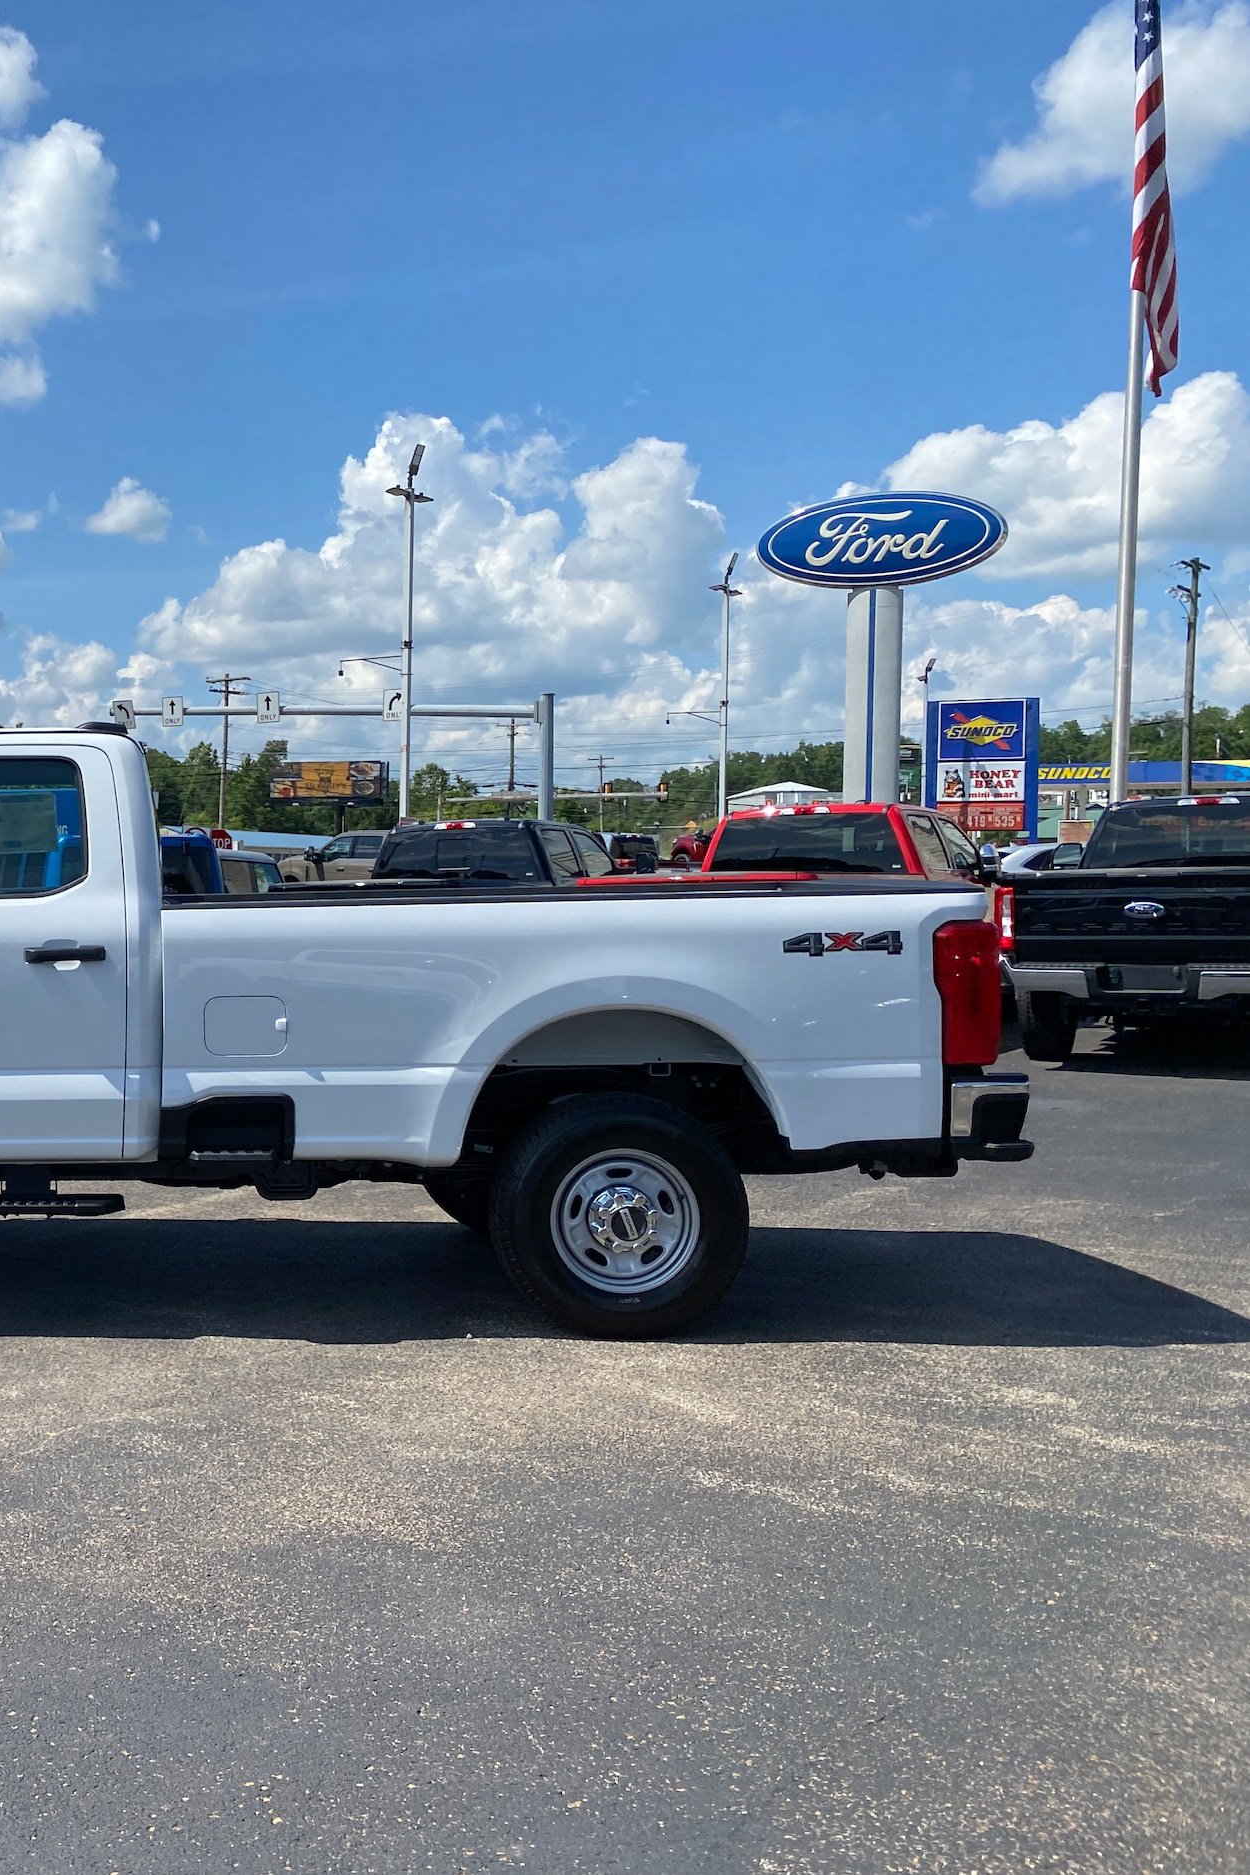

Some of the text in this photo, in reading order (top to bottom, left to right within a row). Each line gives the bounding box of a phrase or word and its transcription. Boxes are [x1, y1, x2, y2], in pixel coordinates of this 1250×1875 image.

[805, 510, 949, 567] Ford
[950, 725, 1016, 738] SUNOCO
[969, 769, 1022, 779] HONEY
[1038, 766, 1111, 780] SUNOCO
[974, 779, 1015, 789] BEAR
[212, 838, 231, 849] TOP
